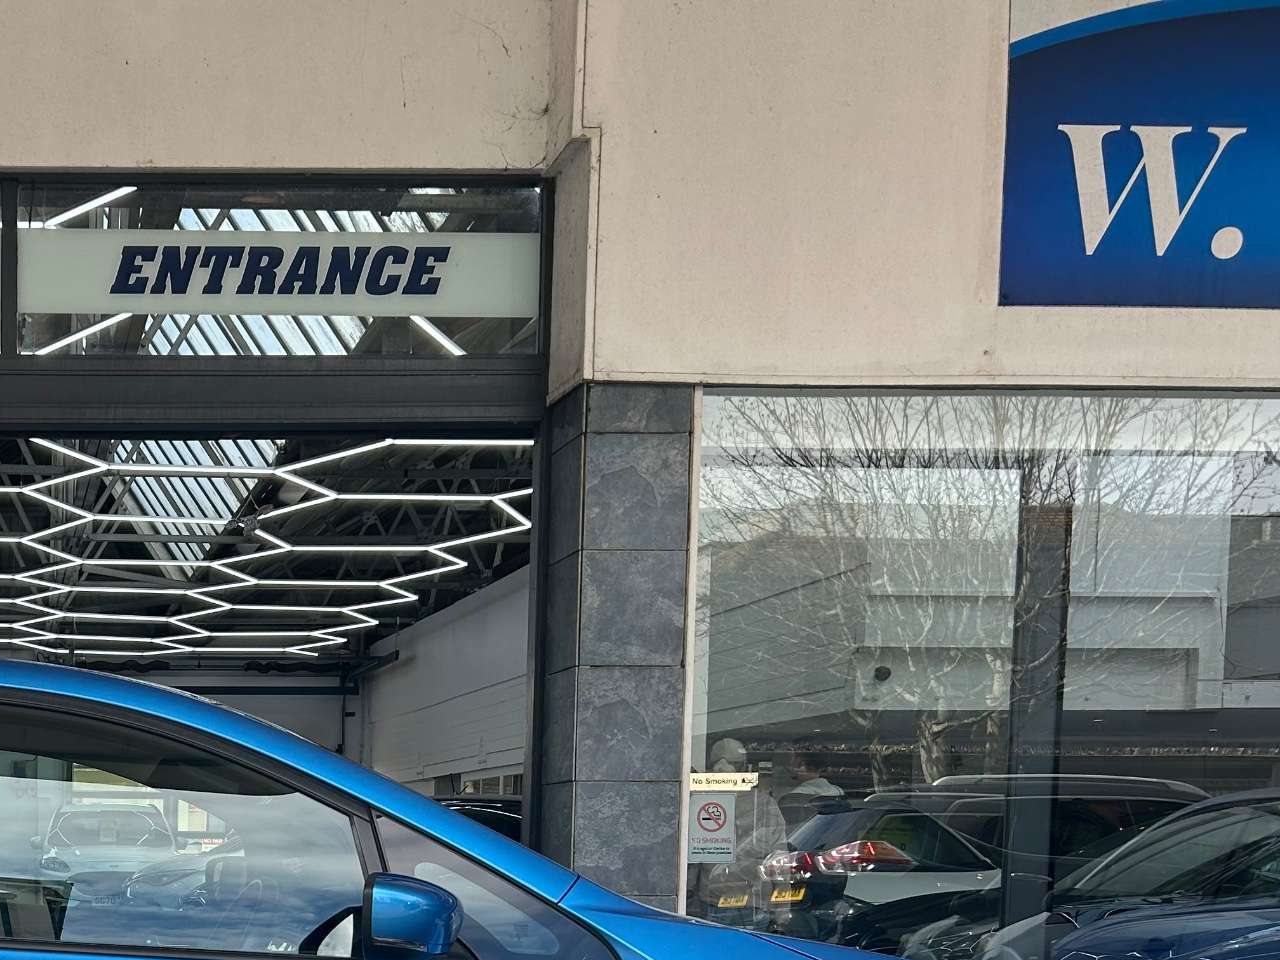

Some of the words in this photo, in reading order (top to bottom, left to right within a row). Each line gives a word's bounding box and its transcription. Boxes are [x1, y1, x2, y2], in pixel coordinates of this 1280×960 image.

[1057, 124, 1248, 260] W.
[109, 245, 451, 296] ENTRANCE
[705, 777, 738, 786] Smoking
